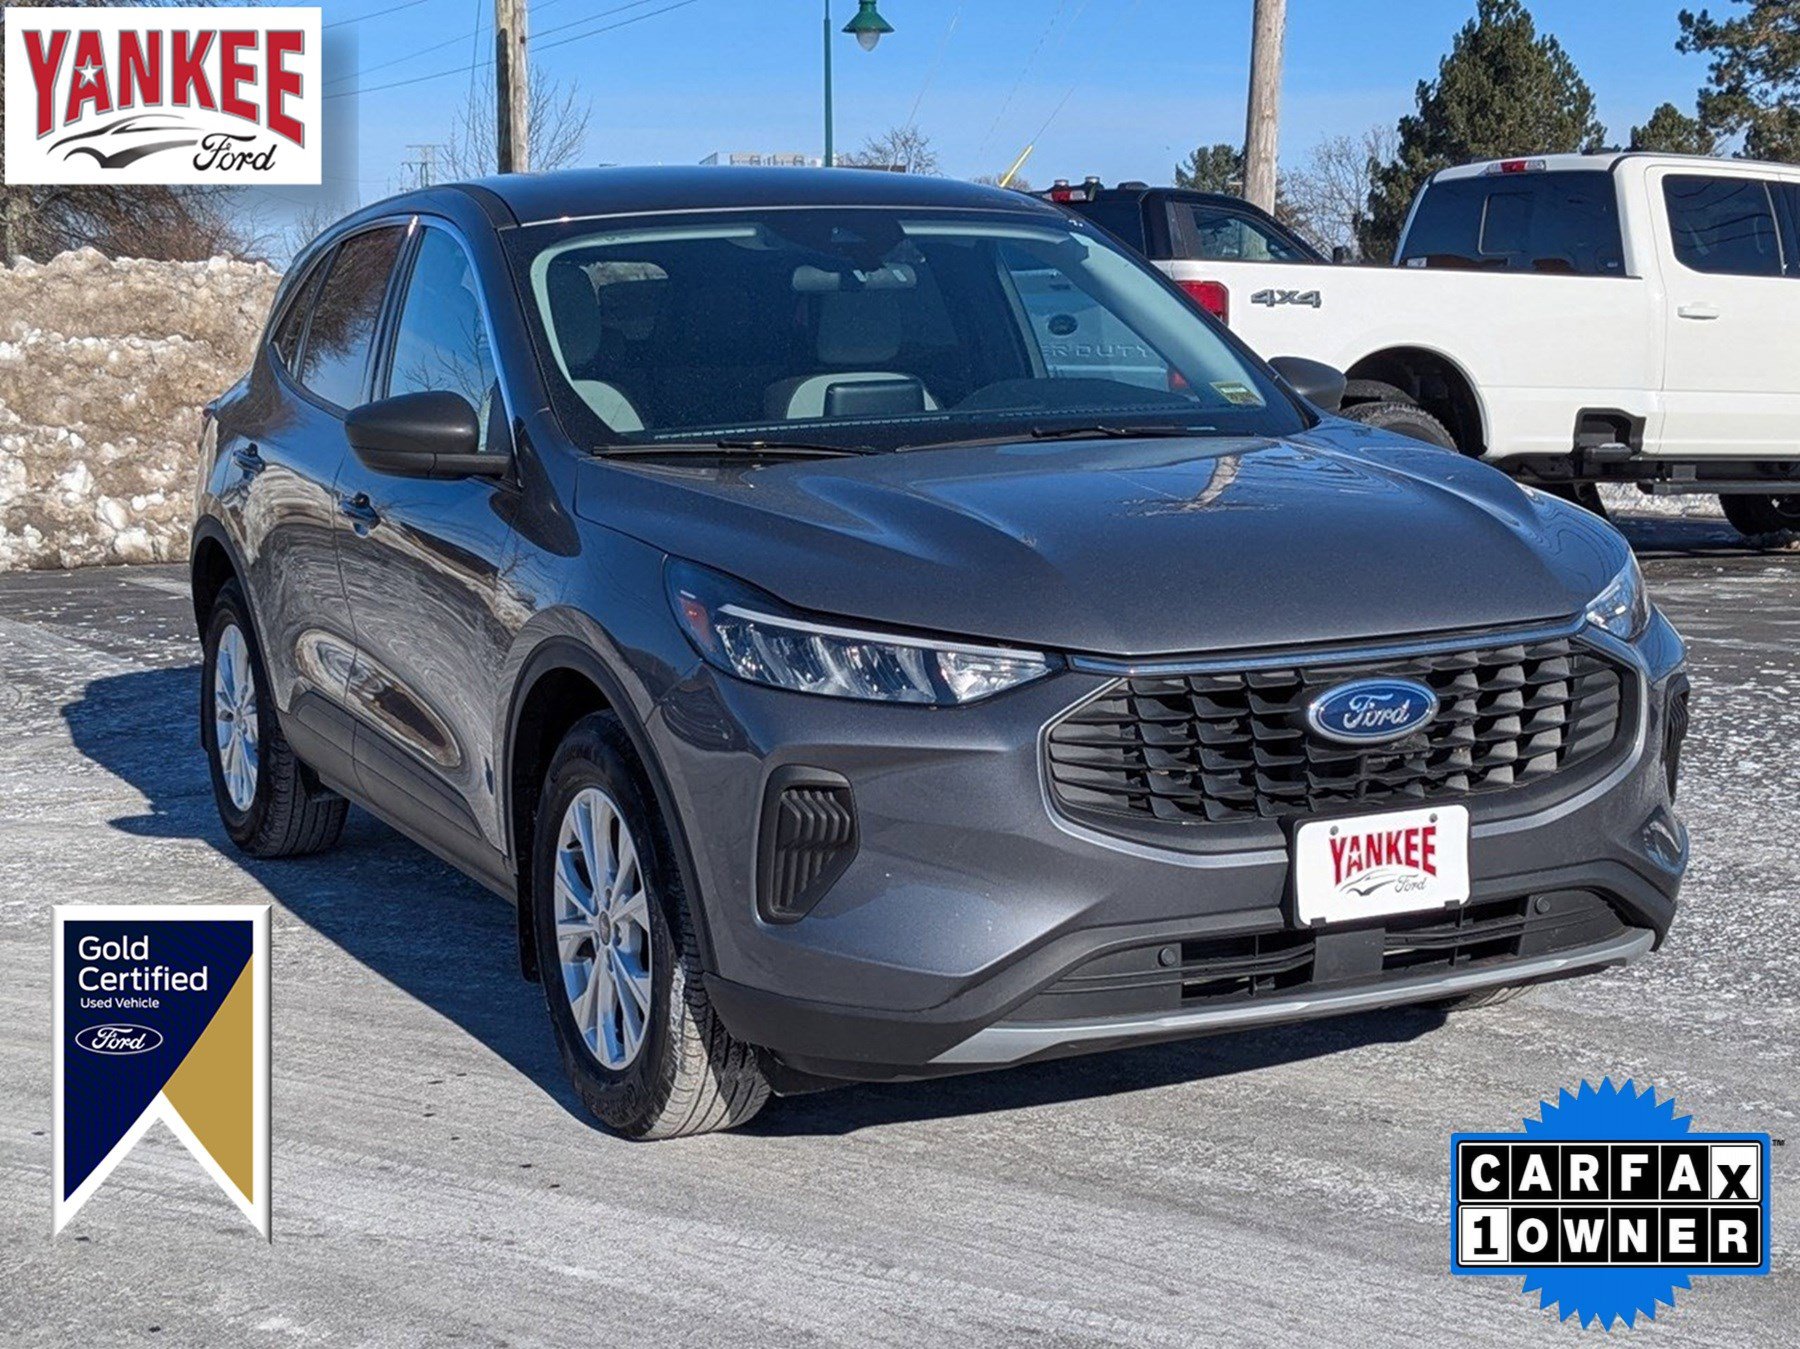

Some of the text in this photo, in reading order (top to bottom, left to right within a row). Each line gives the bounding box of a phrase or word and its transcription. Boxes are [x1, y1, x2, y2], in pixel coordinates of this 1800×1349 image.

[1076, 345, 1148, 358] DUTY
[1343, 693, 1410, 728] Ford
[1329, 825, 1438, 886] YANKEE
[1394, 873, 1427, 893] Ford
